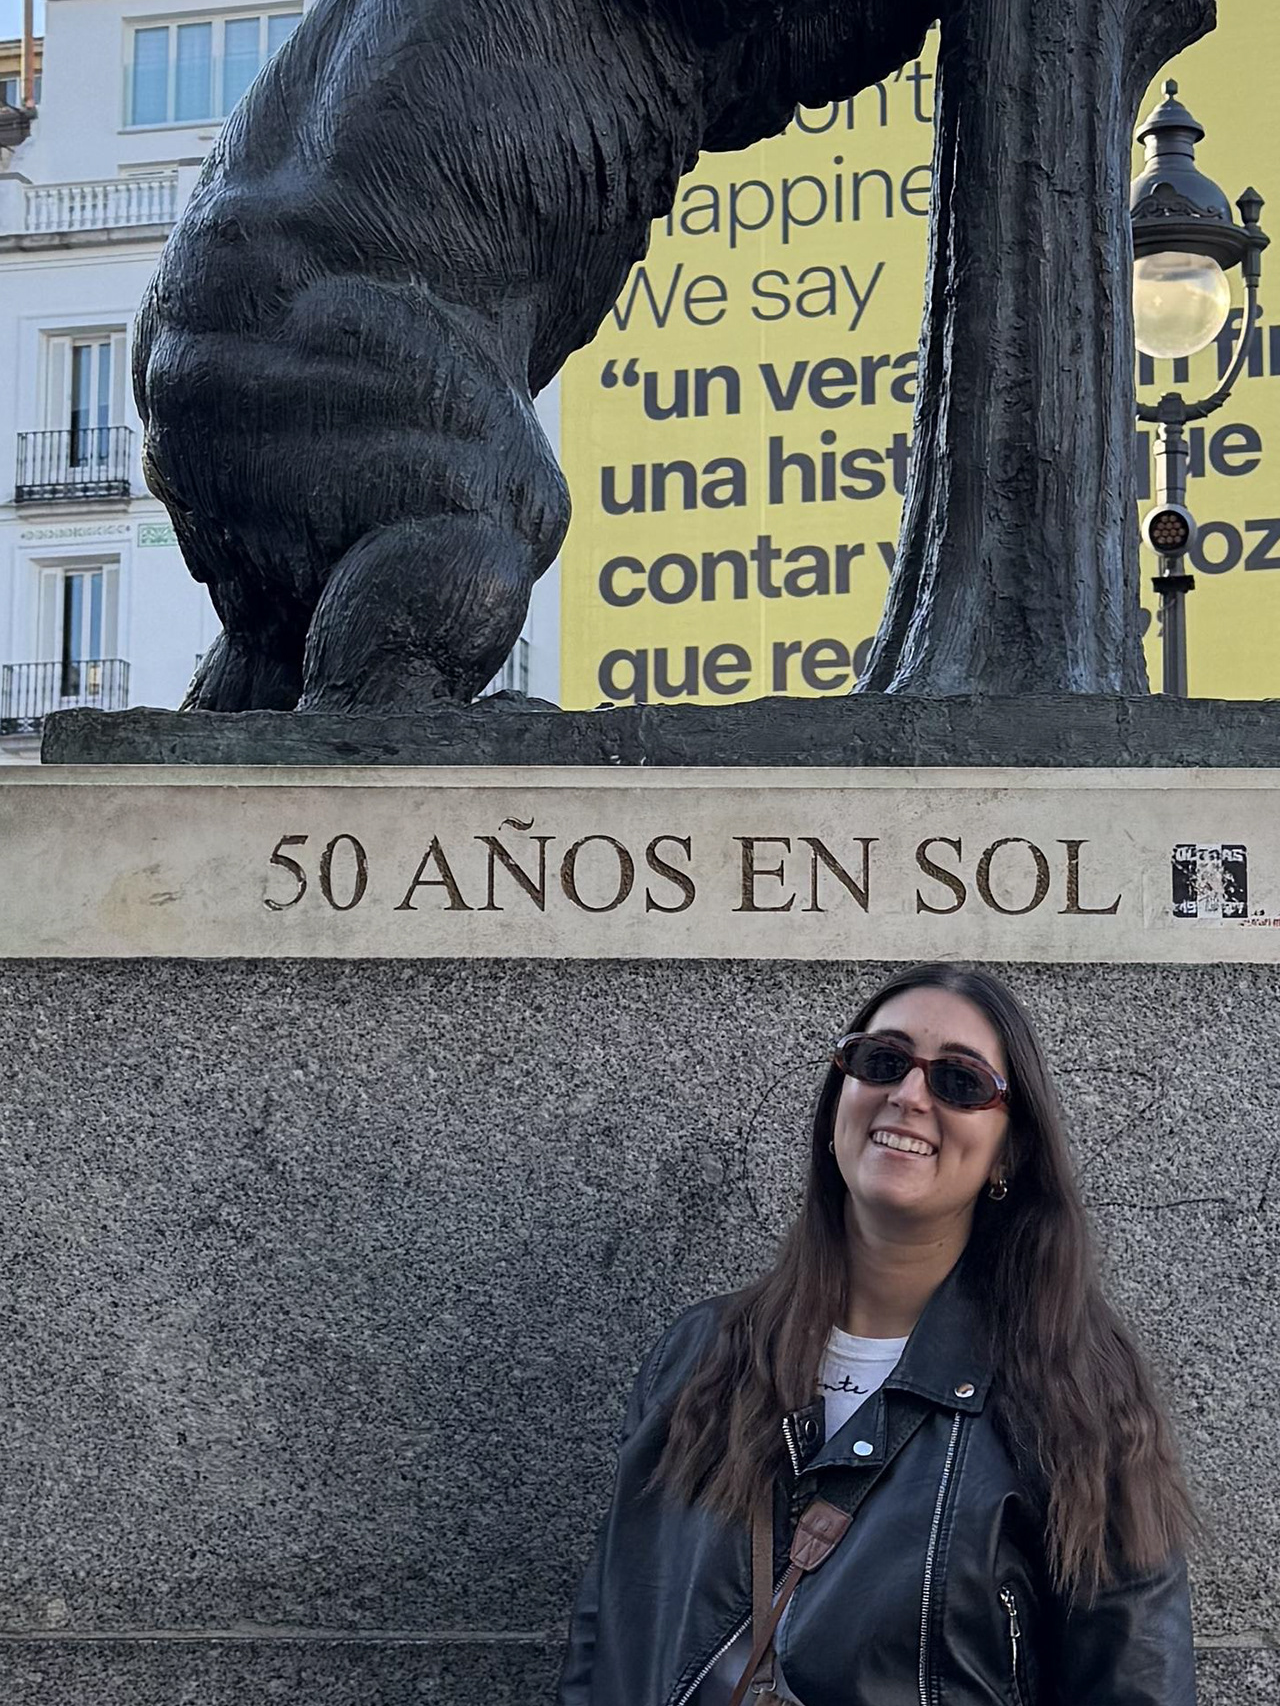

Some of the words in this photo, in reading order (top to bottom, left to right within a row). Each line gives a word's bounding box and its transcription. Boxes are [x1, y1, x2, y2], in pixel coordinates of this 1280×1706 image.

[780, 61, 933, 135] on't
[613, 262, 728, 331] We
[750, 261, 886, 332] say
[600, 456, 748, 516] una
[598, 534, 866, 608] contar
[598, 643, 753, 704] que
[261, 833, 368, 913] 50
[393, 816, 697, 916] AÑOS
[731, 835, 881, 915] EN
[914, 835, 1123, 917] SOL
